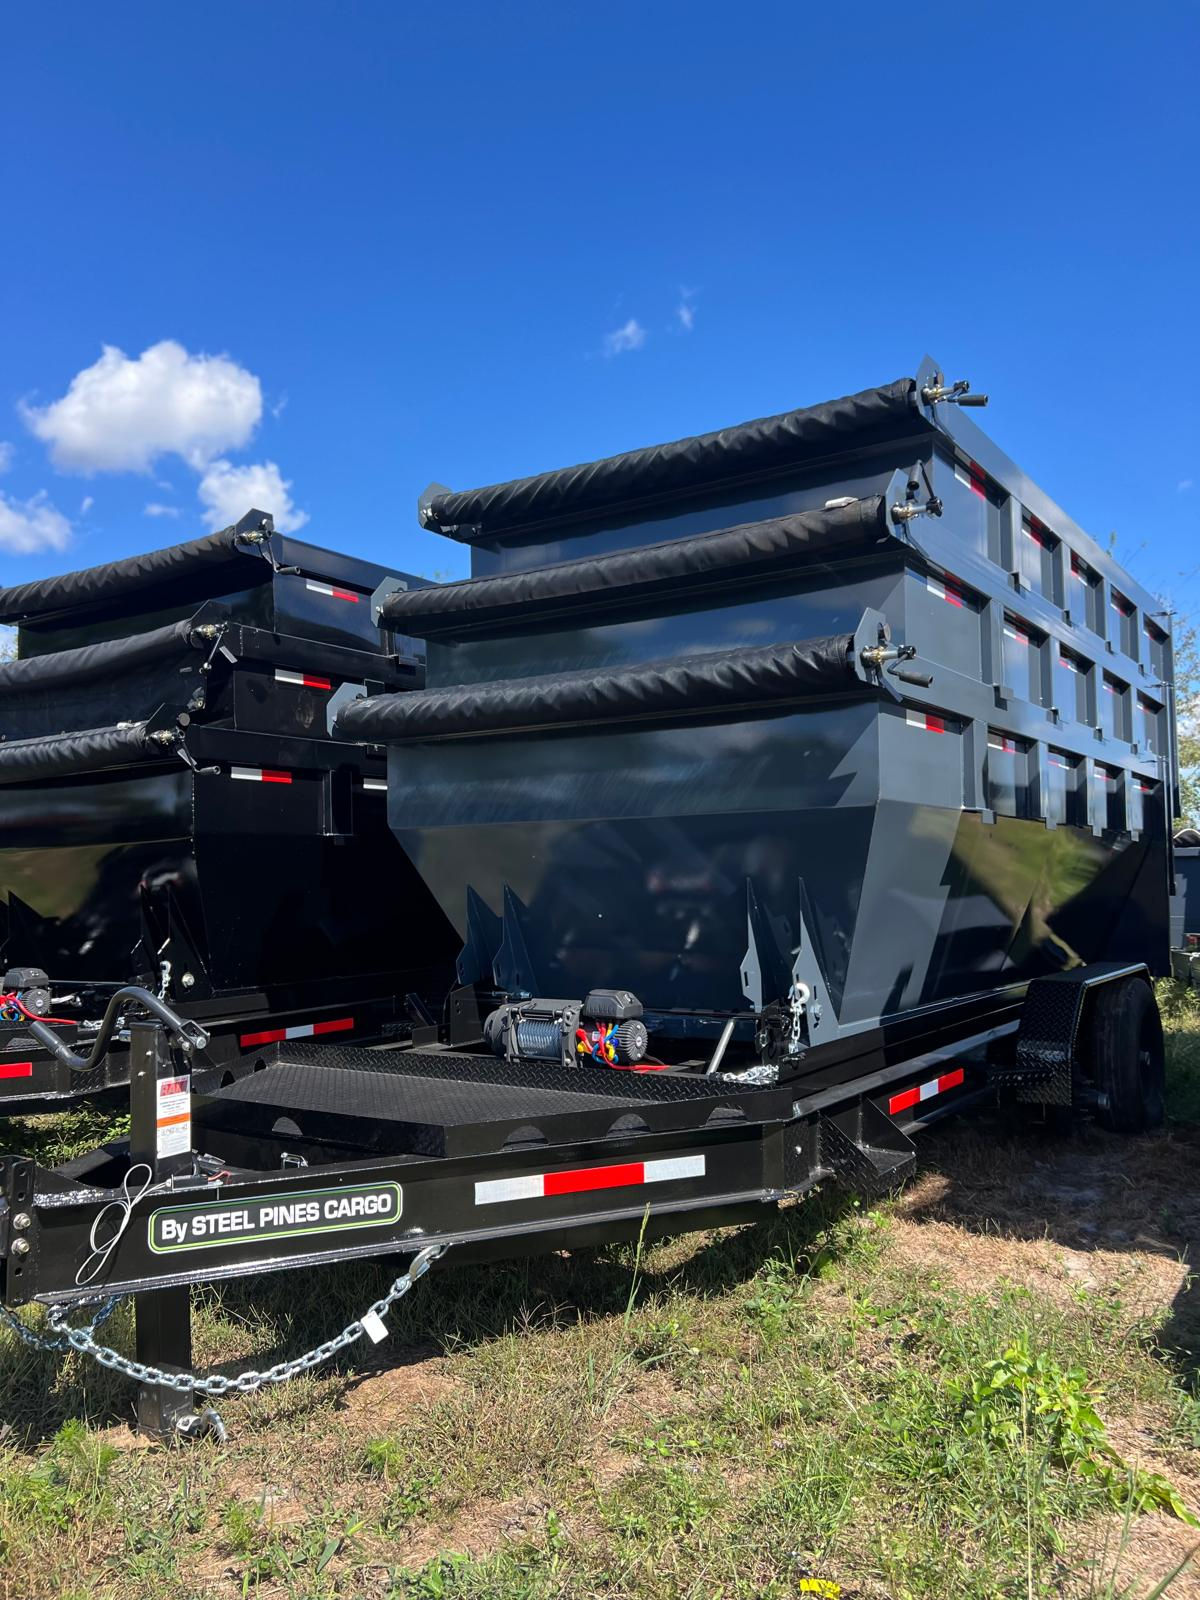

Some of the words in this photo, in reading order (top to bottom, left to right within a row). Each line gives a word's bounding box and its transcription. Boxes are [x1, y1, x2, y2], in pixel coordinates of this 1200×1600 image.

[161, 1219, 187, 1243] By
[192, 1210, 255, 1236] STEEL
[259, 1202, 319, 1228] PINES
[324, 1193, 392, 1219] CARGO
